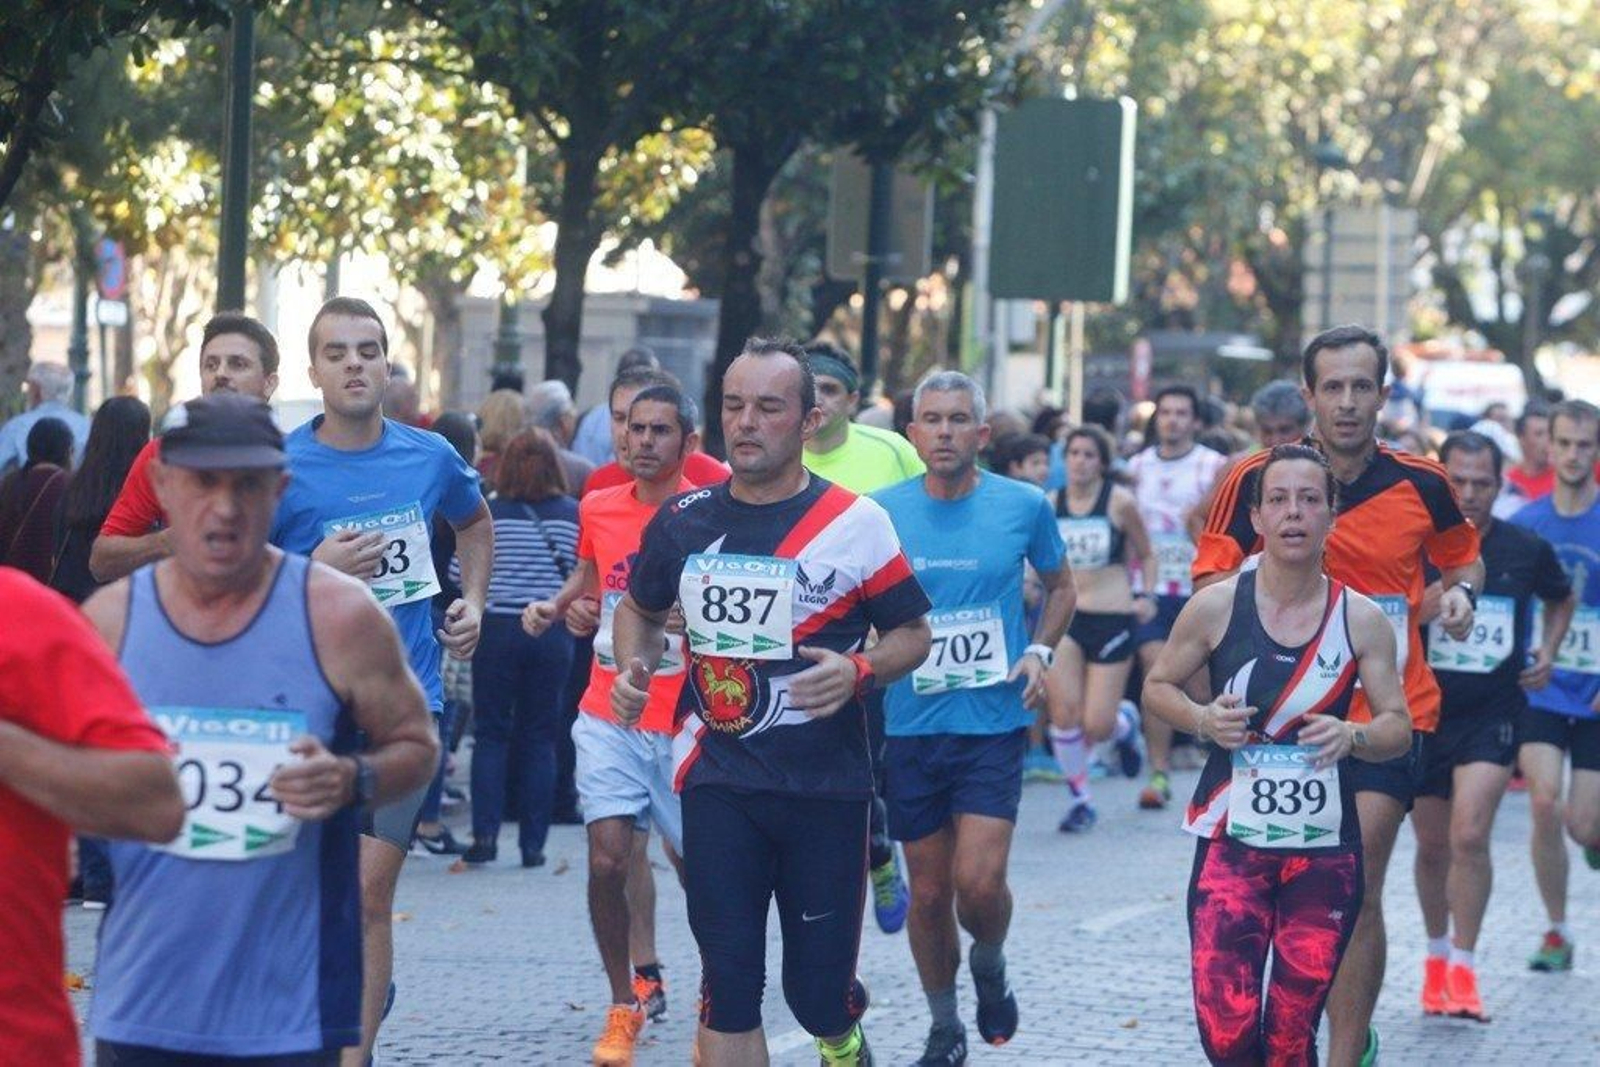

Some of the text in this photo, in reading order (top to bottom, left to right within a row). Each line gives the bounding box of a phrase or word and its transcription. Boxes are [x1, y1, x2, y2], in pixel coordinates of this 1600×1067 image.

[702, 585, 778, 625] 837
[799, 594, 829, 605] LEGIO
[931, 631, 993, 667] 702
[1251, 778, 1327, 815] 839
